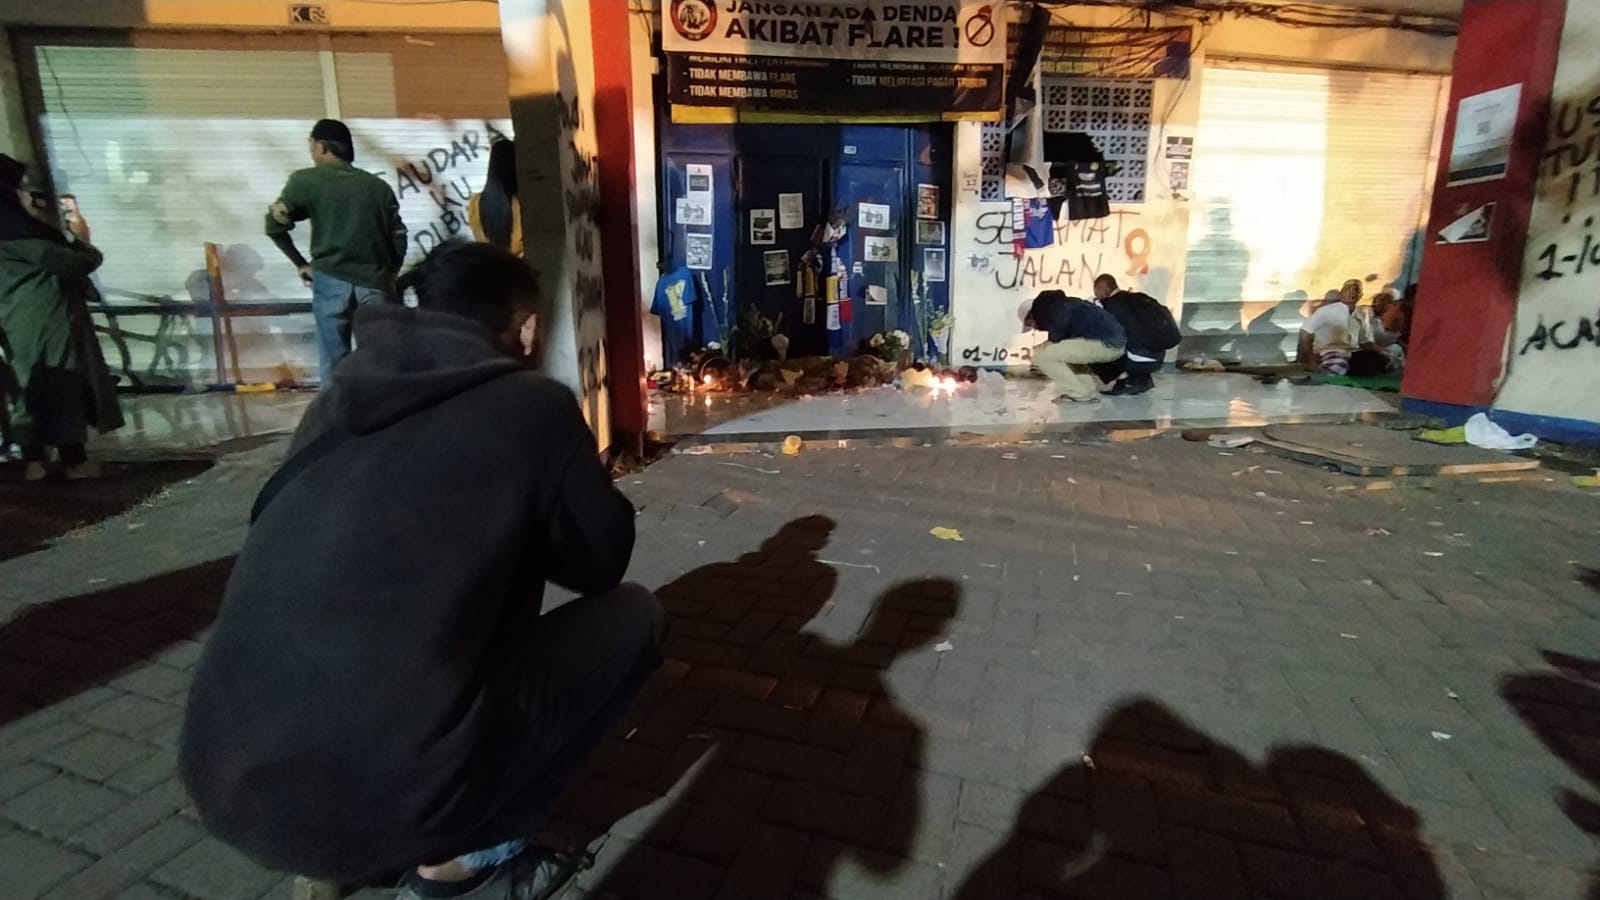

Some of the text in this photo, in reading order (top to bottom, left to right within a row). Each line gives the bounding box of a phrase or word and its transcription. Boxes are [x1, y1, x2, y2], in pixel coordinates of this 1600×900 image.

[883, 5, 957, 24] DENDA
[725, 17, 839, 46] AKIBAT
[848, 22, 944, 48] FLARE
[689, 67, 717, 80] TIDAK
[718, 69, 768, 82] MEMBAWA
[689, 85, 717, 98] TIDAK
[718, 86, 768, 99] MEMBAWA
[379, 121, 507, 199] AUDARA
[429, 176, 471, 212] KU
[974, 210, 1140, 248] SEAMAT
[995, 252, 1102, 290] JALAN
